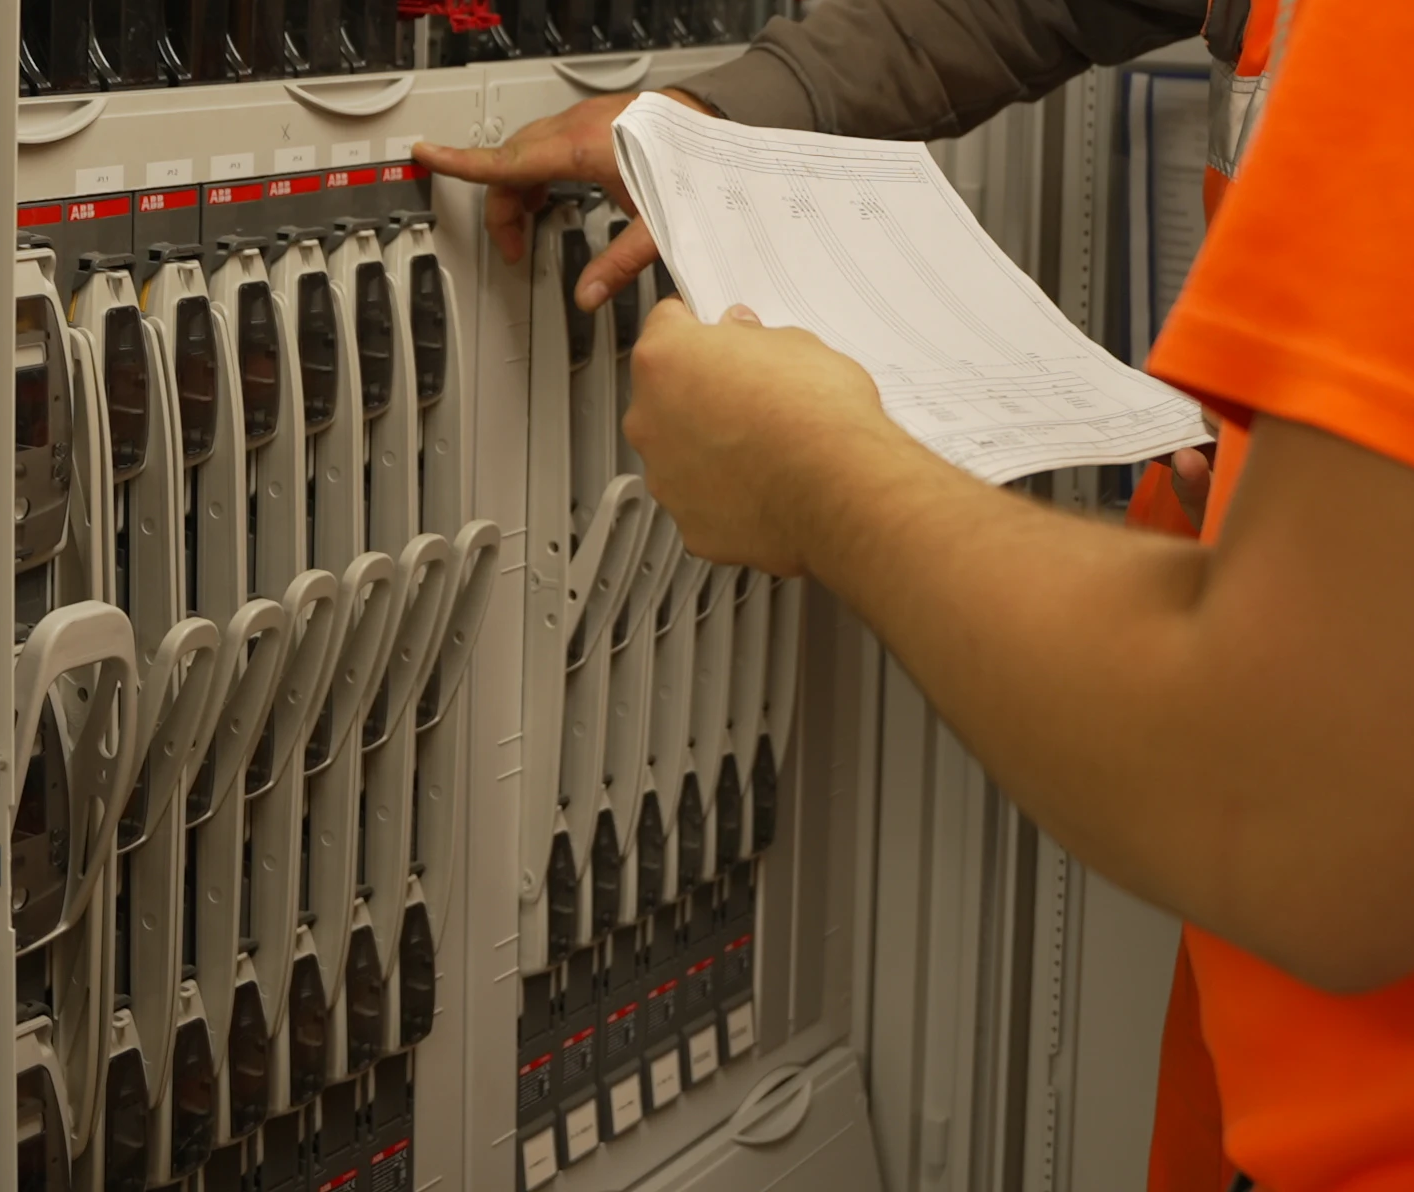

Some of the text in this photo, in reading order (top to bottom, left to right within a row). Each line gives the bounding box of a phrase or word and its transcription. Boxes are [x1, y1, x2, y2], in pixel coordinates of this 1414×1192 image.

[327, 172, 348, 188] ABB
[382, 166, 403, 182] ABB
[209, 188, 232, 204] ABB
[269, 180, 291, 196] ABB
[141, 194, 164, 211] ABB
[70, 203, 95, 221] ABB
